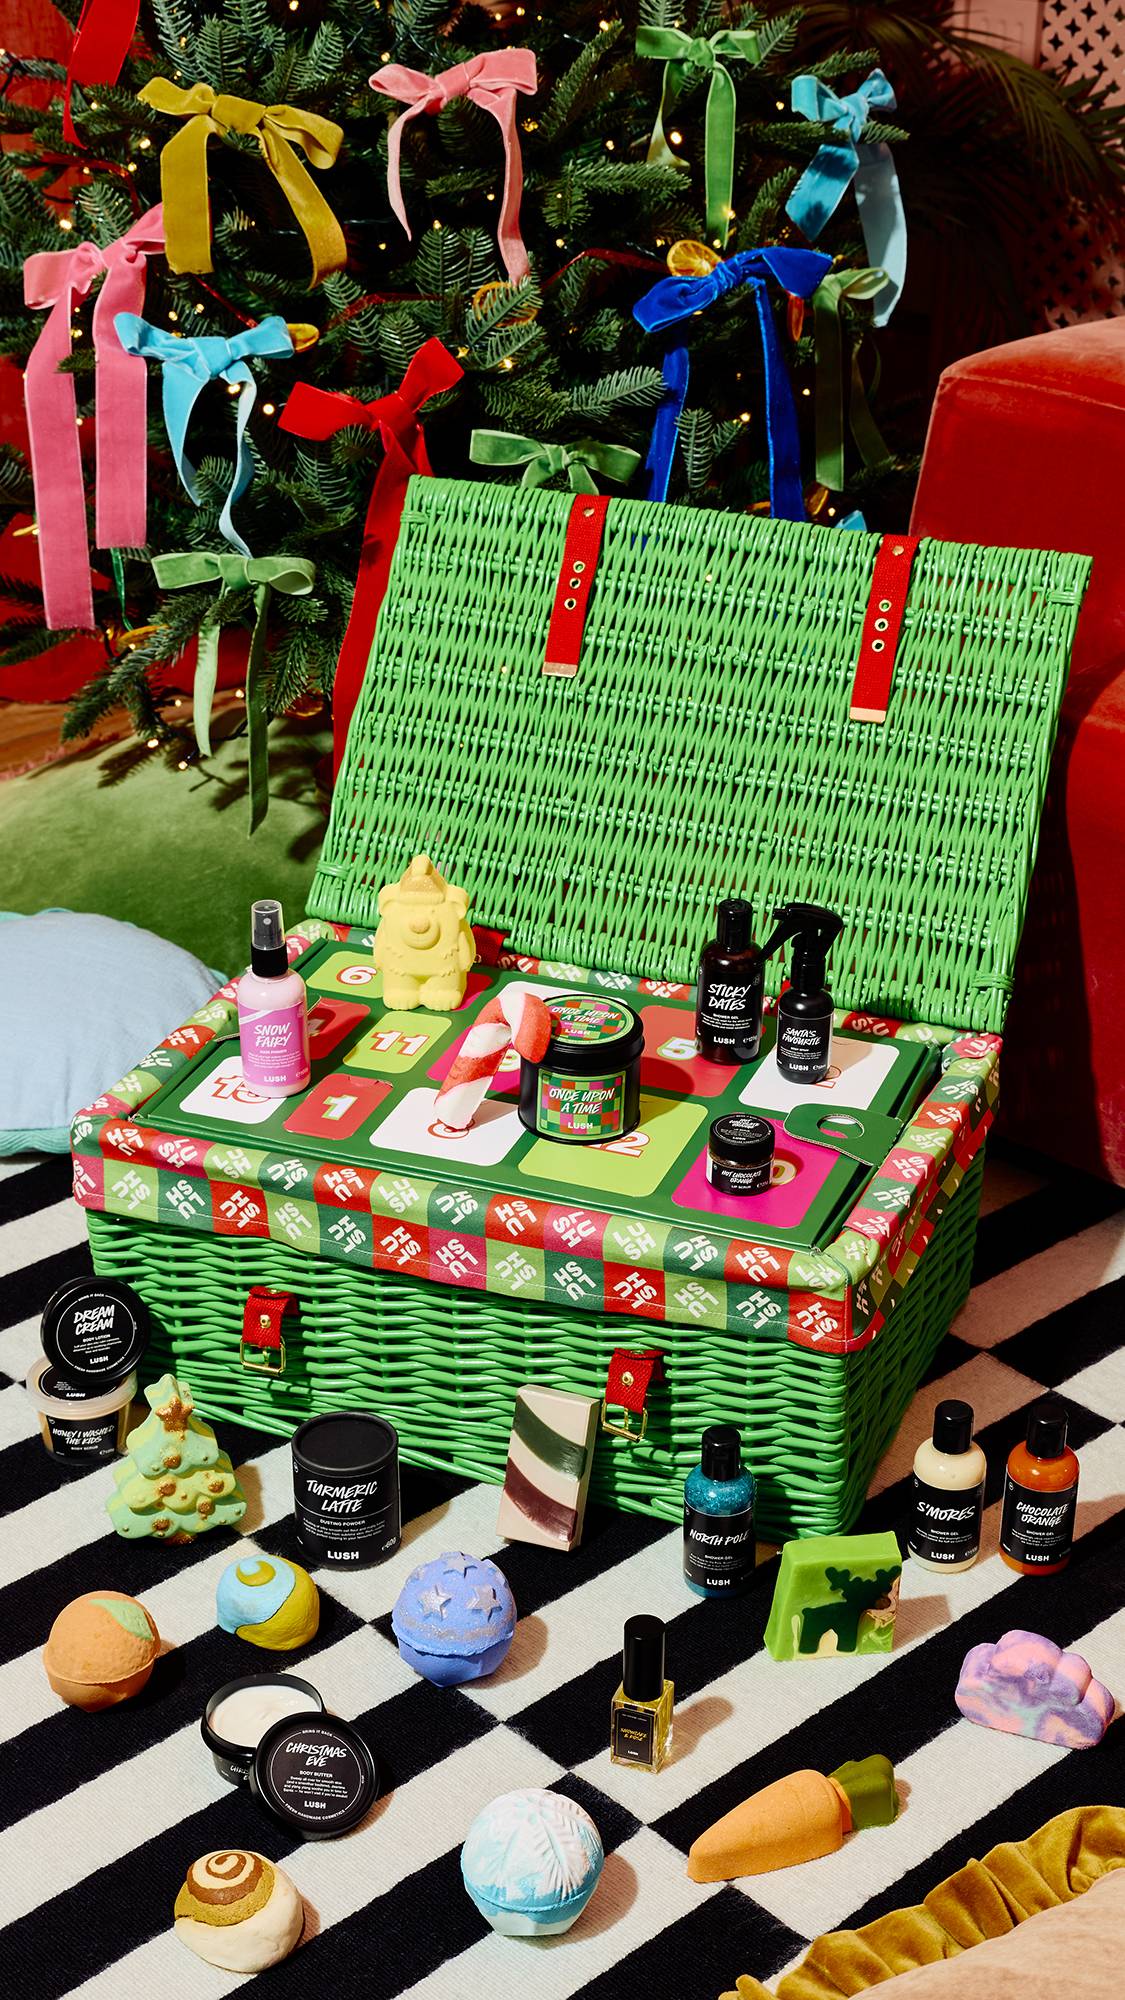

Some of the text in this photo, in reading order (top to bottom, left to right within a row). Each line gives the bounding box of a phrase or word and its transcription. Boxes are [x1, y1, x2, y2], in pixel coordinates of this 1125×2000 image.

[336, 964, 377, 986] 6
[707, 983, 751, 998] STICKY
[708, 996, 746, 1011] DATES
[551, 1006, 620, 1020] ONCE UPON
[573, 1015, 601, 1025] TIME
[254, 1022, 291, 1036] SNOW
[786, 1027, 817, 1038] SANTA'S
[255, 1032, 292, 1048] FAIRY
[370, 1029, 430, 1057] 11
[713, 1036, 735, 1045] LUSH
[782, 1033, 821, 1046] FAVOURITE
[789, 1063, 809, 1071] LUSH
[264, 1075, 287, 1083] LUSH
[549, 1087, 615, 1102] ONCE UPON
[322, 1093, 358, 1121] 1
[561, 1102, 601, 1114] A TIME
[567, 1121, 594, 1129] LUSH
[73, 1304, 115, 1324] DREAM
[75, 1317, 114, 1336] CREAM
[89, 1355, 109, 1364] LUSH
[52, 1425, 114, 1438] HONEY I WASHED
[65, 1436, 102, 1445] THE KIDS
[306, 1479, 378, 1500] TURMERIC
[321, 1498, 365, 1513] LATTE
[916, 1501, 976, 1521] S'MORES
[1016, 1501, 1069, 1516] CHOCOLATE
[319, 1519, 342, 1527] DUSTING
[1021, 1514, 1063, 1527] ORANGE
[689, 1529, 750, 1546] NORTH POLE
[327, 1550, 360, 1560] LUSH
[931, 1551, 955, 1560] LUSH
[706, 1578, 731, 1586] LUSH
[286, 1742, 347, 1758] CHRISTMAS
[305, 1756, 329, 1767] EVE
[304, 1800, 326, 1809] LUSH
